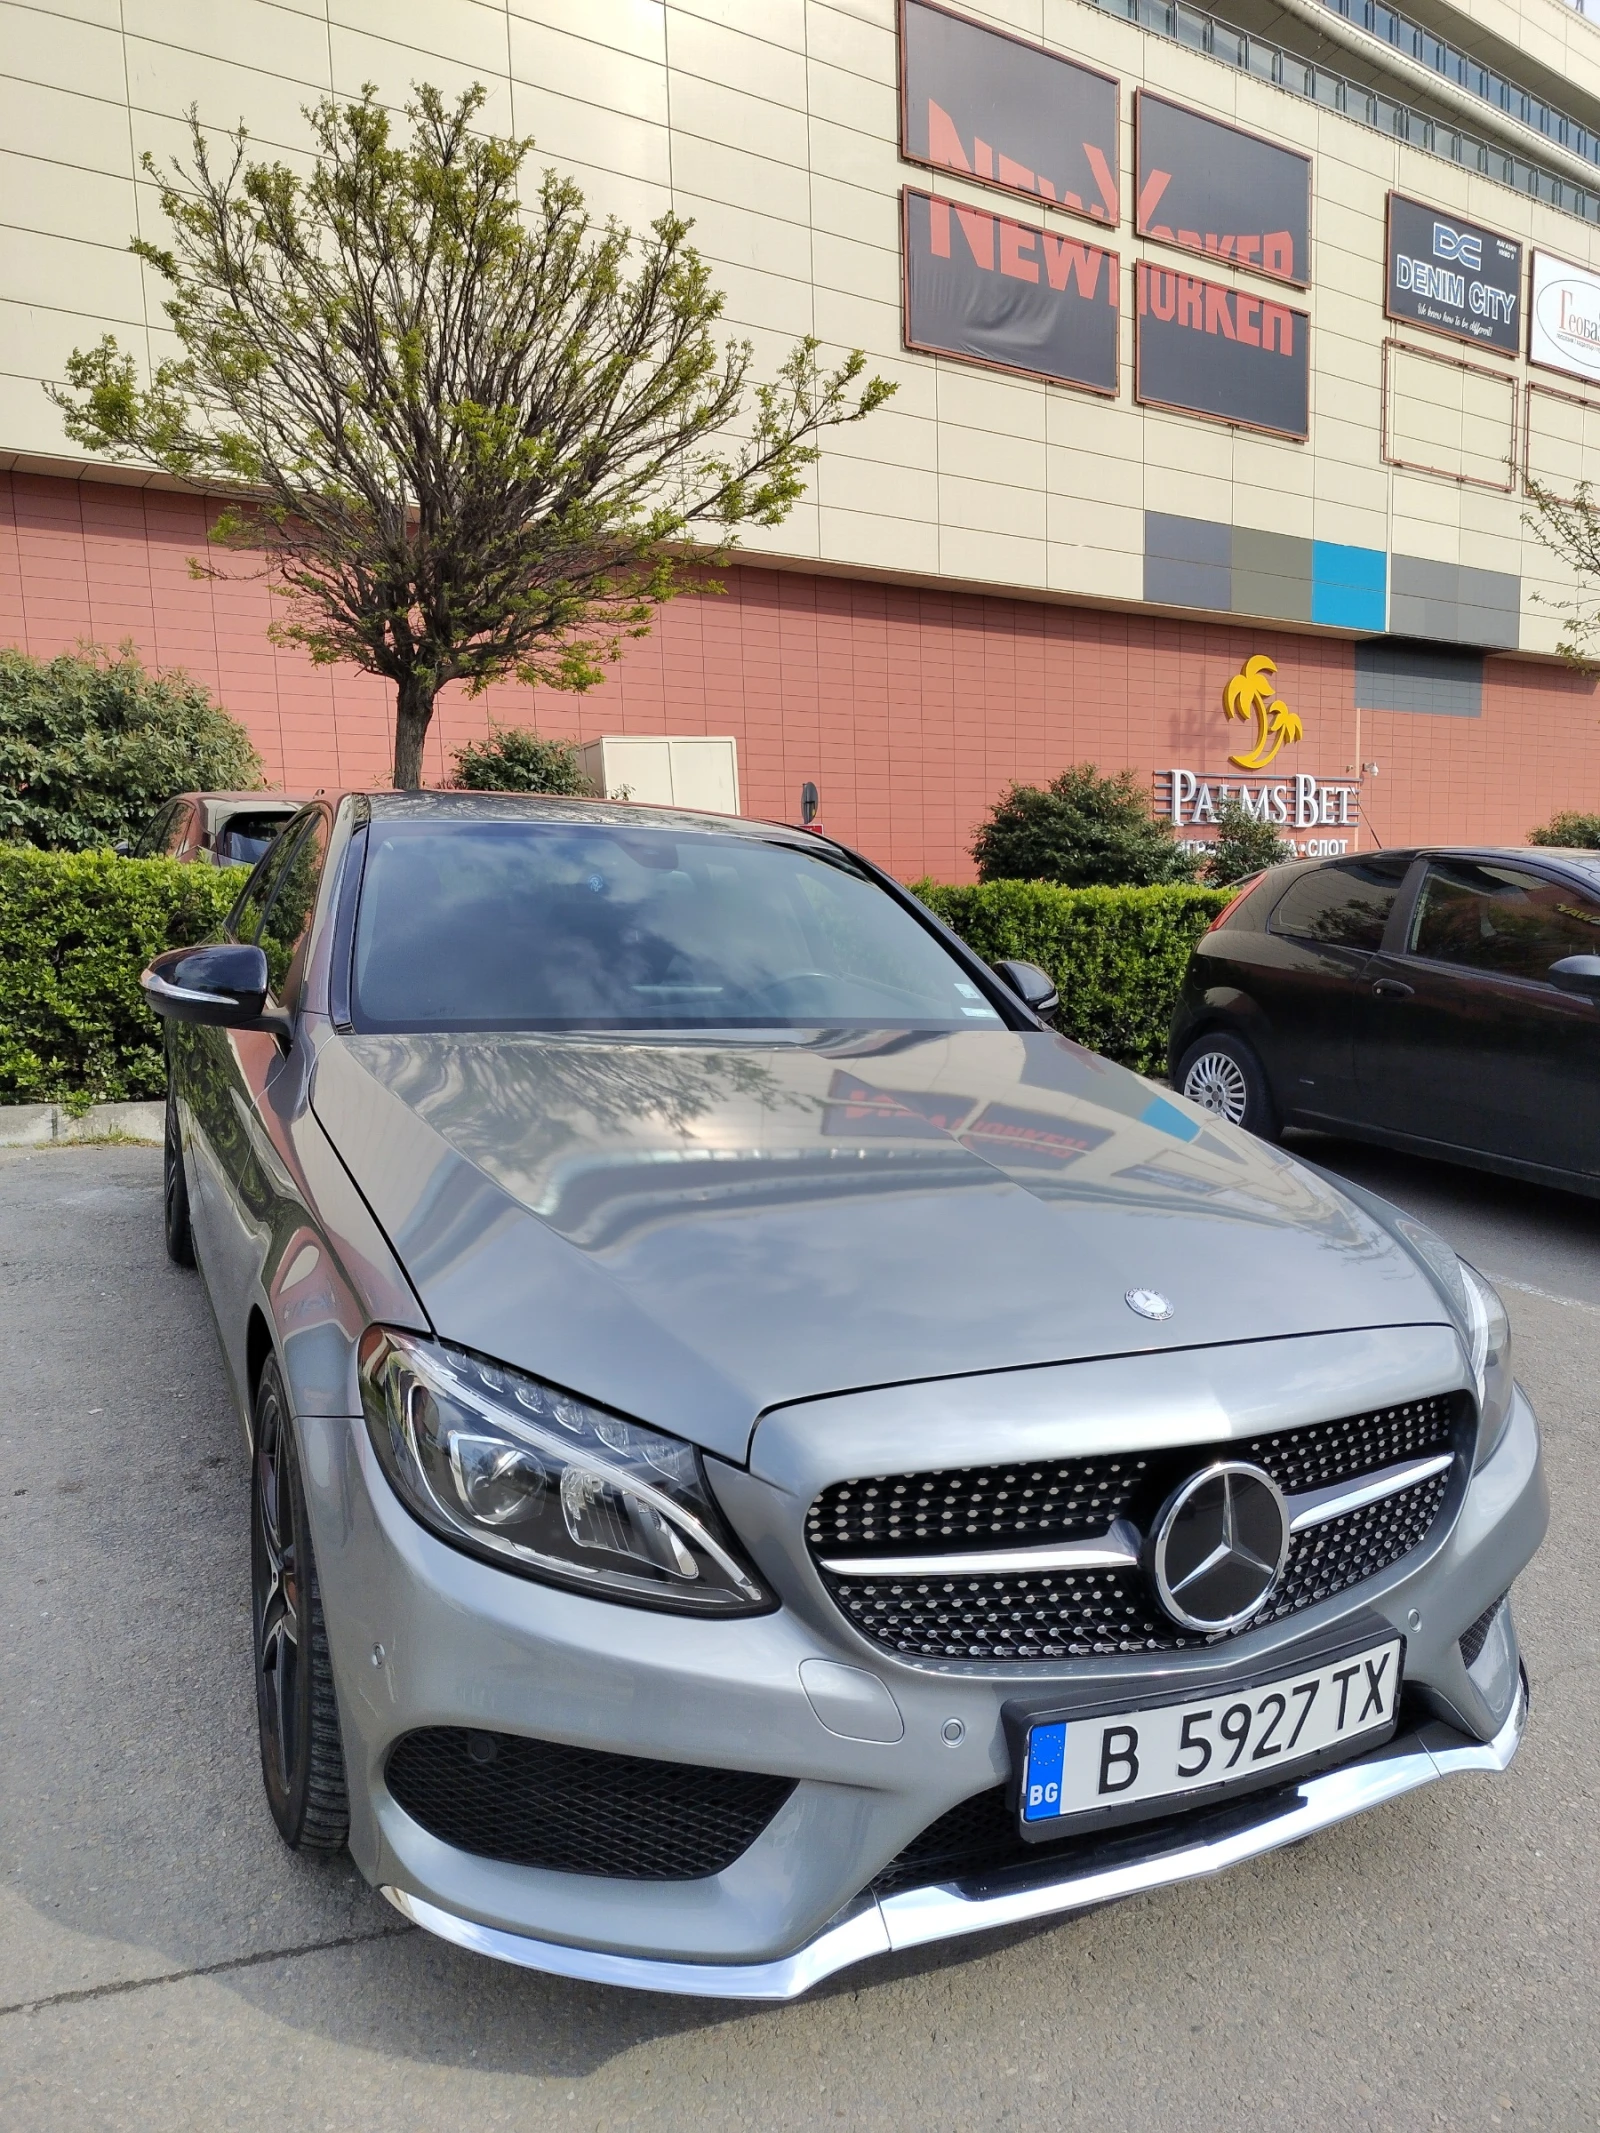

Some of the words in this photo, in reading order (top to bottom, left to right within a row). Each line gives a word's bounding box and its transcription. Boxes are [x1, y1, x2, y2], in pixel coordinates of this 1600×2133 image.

[1396, 254, 1464, 308] DENIM
[1469, 281, 1516, 324] CITY
[1442, 311, 1454, 325] how
[1454, 315, 1461, 327] to
[1461, 317, 1469, 329] be
[1295, 773, 1356, 828] BET
[1098, 1726, 1139, 1795] B
[1177, 1681, 1320, 1778] 5927
[1332, 1651, 1391, 1731] TX
[1029, 1782, 1058, 1807] BG
